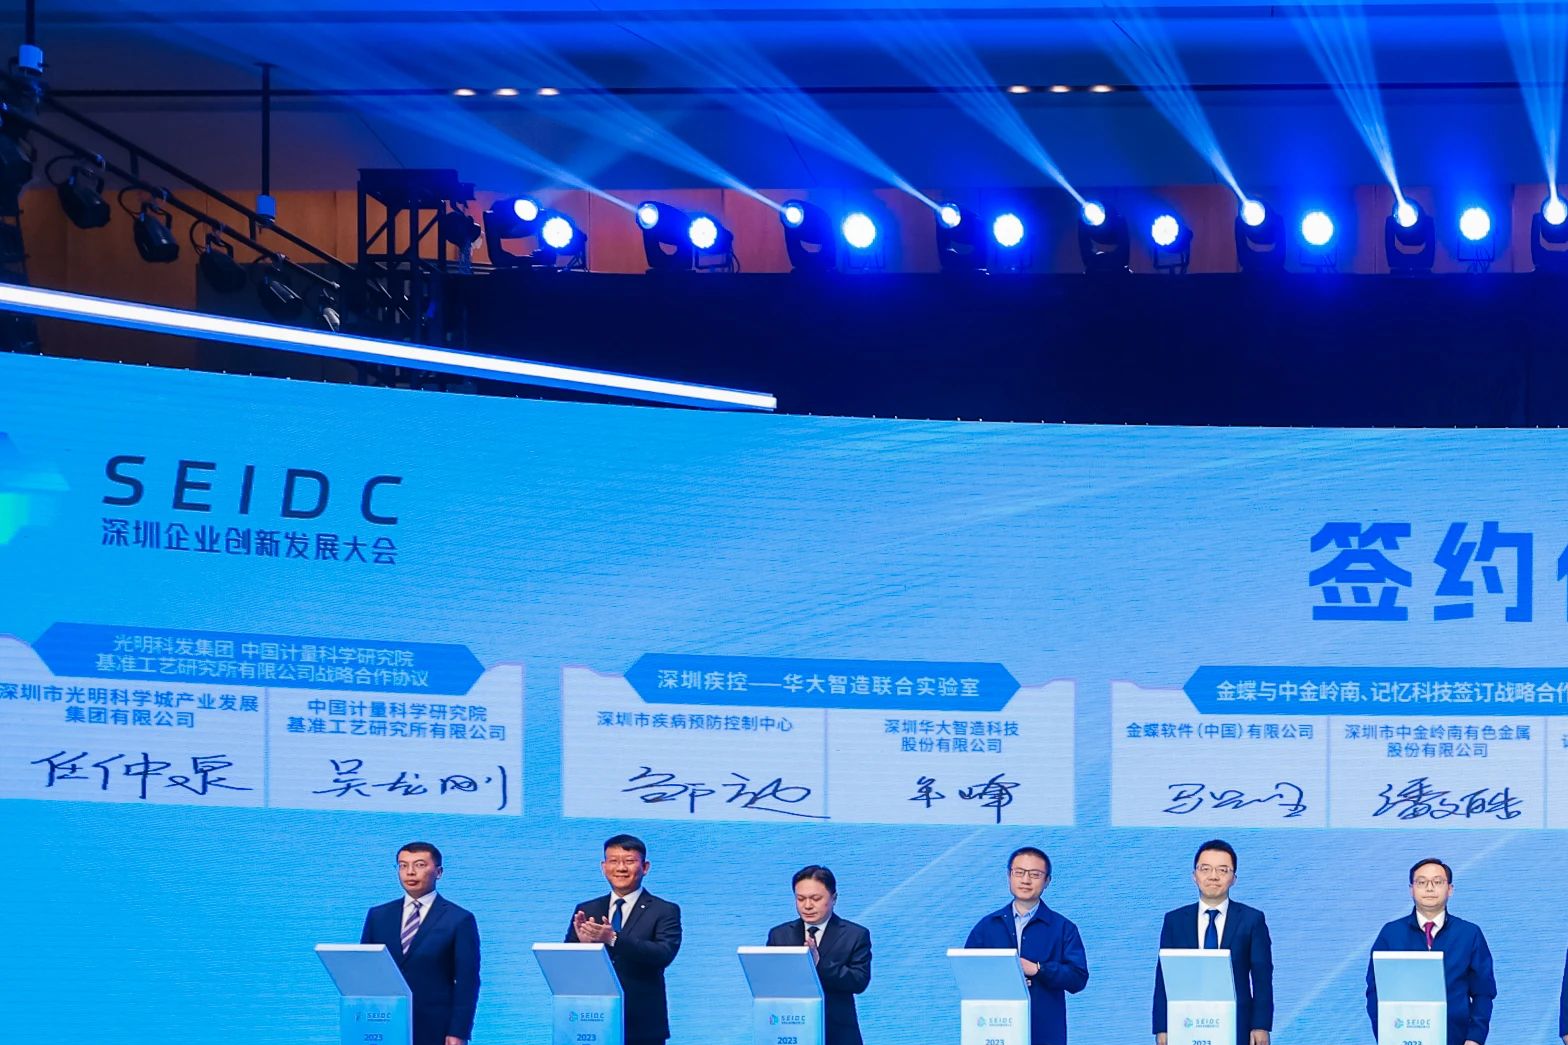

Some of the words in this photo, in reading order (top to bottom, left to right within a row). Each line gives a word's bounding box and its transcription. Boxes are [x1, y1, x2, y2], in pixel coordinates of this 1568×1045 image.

[103, 455, 402, 526] SEIDC
[101, 518, 398, 565] 深圳企业创新发展大会
[113, 634, 235, 658] 光明科发集团
[241, 642, 414, 668] 中国计量科学研究院
[96, 653, 428, 688] 基准工艺研究所有限公司战略合作协议
[0, 683, 258, 712] 深圳市光明科学城产业发展
[65, 707, 194, 728] 集团有限公司
[307, 699, 487, 722] 中国计量科学研究院
[597, 710, 793, 733] 深圳市疾病预防控制中心
[286, 717, 506, 742] 基准工艺研究所有限公司
[884, 719, 1019, 737] 深圳华大智造科技
[1345, 724, 1531, 742] 深圳市中金岭南有色金属
[901, 736, 1002, 754] 股份有限公司
[1387, 743, 1488, 759] 股份有限公司
[364, 1033, 383, 1041] 2023
[576, 1033, 597, 1042] 2023
[777, 1036, 798, 1045] 2023
